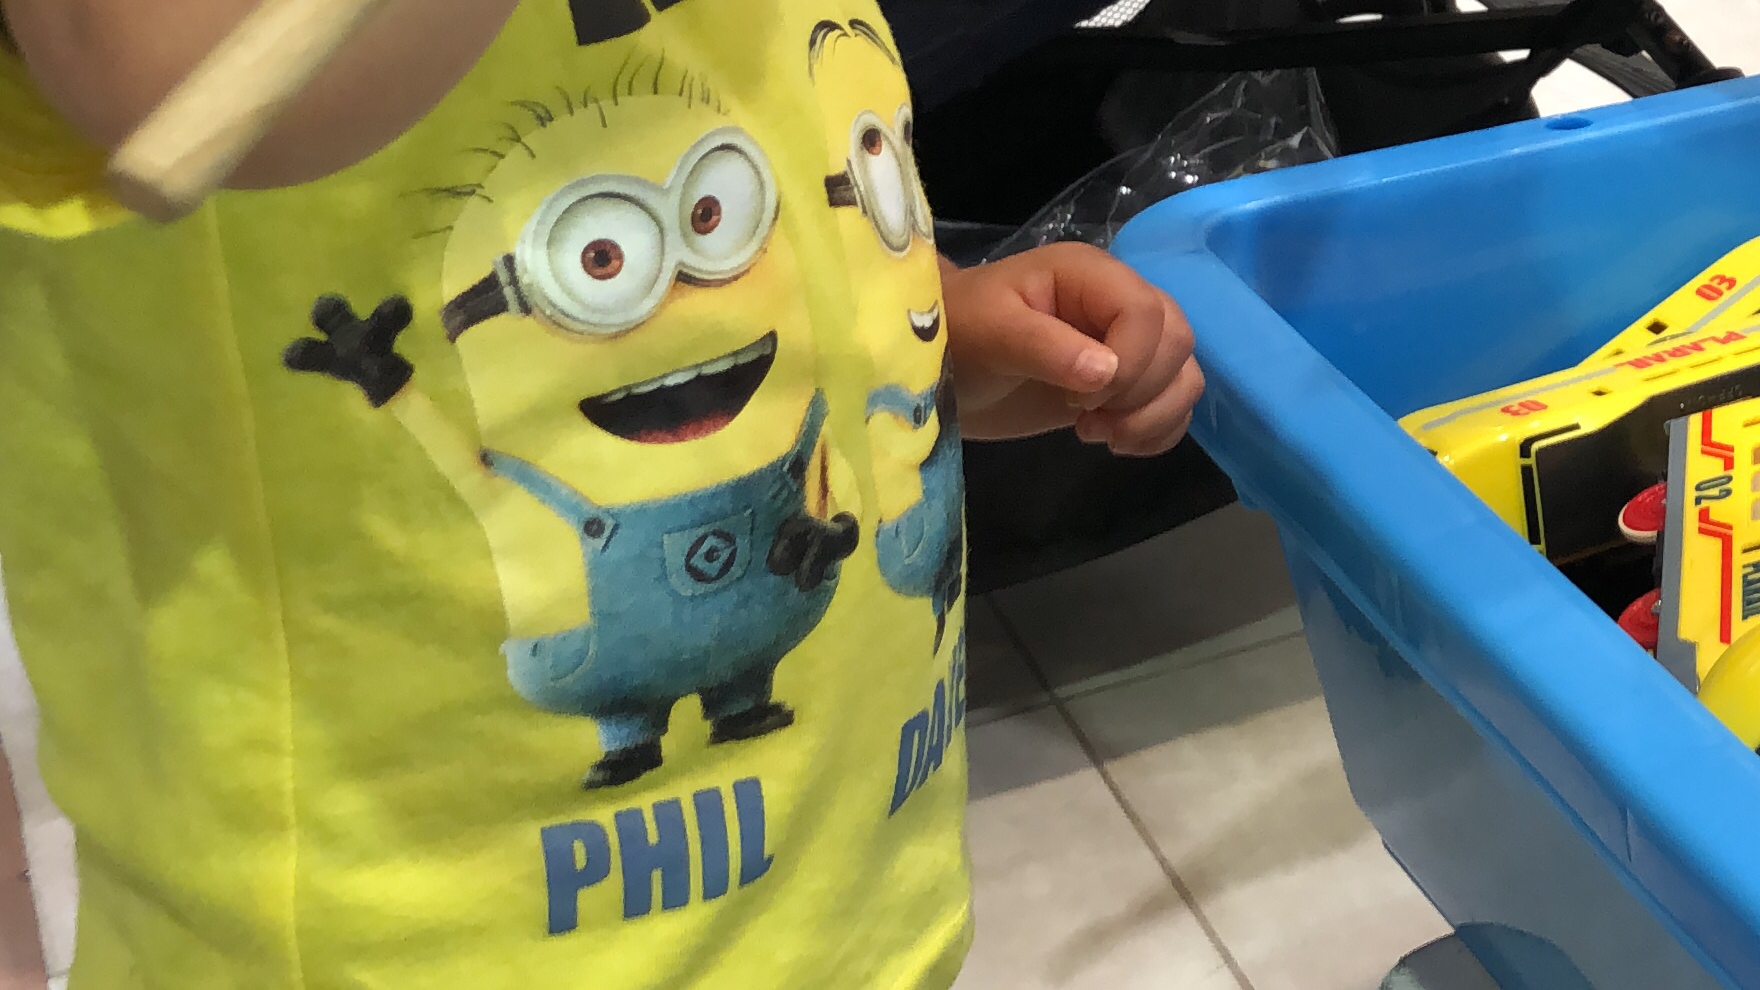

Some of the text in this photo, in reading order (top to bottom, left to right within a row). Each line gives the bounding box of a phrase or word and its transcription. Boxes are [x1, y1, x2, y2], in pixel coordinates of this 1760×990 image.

[1694, 274, 1738, 301] 03
[1614, 330, 1747, 369] PLARAIL
[1694, 474, 1734, 507] 02
[540, 776, 775, 938] PHIL
